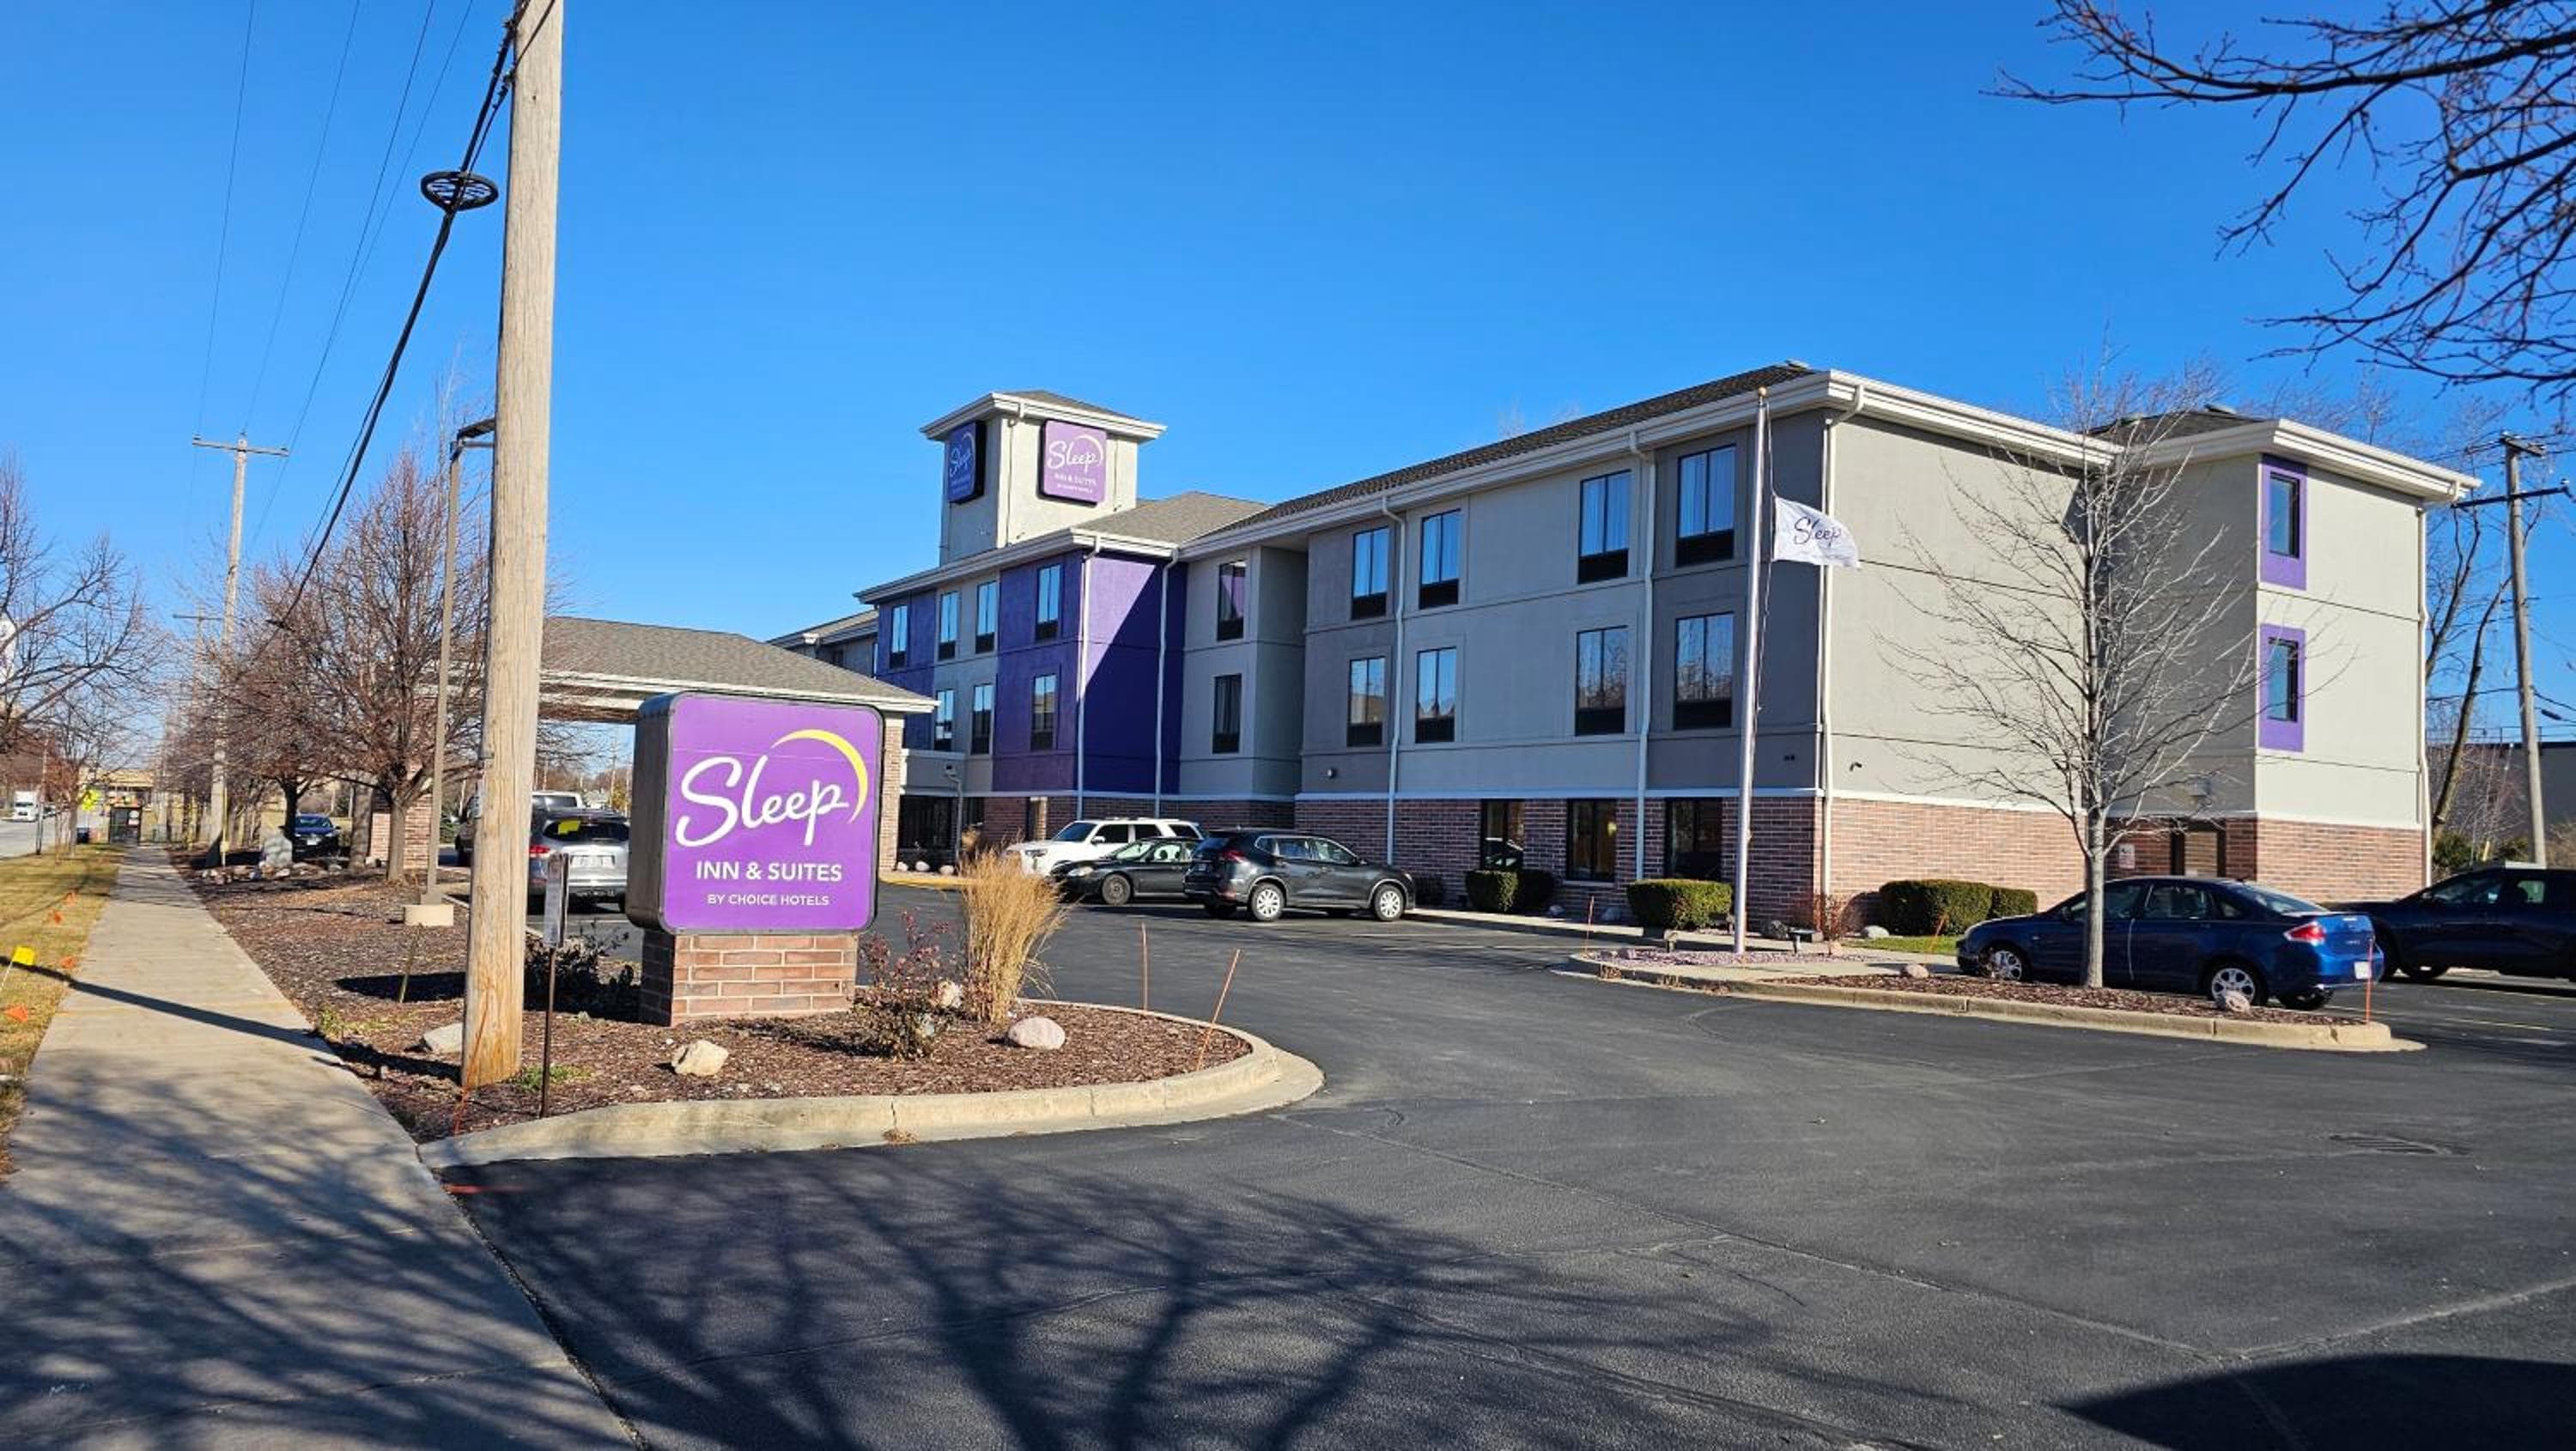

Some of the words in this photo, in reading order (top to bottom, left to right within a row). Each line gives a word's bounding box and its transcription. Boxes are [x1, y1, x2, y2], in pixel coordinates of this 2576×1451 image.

[1048, 440, 1098, 474] Sleep
[1794, 517, 1841, 547] Sleep
[676, 756, 850, 847] Sleep
[696, 860, 739, 880] INN
[746, 861, 762, 881] &
[767, 862, 842, 882] SUITES
[708, 894, 724, 904] BY
[729, 894, 775, 905] CHOICE
[781, 895, 829, 907] HOTELS
